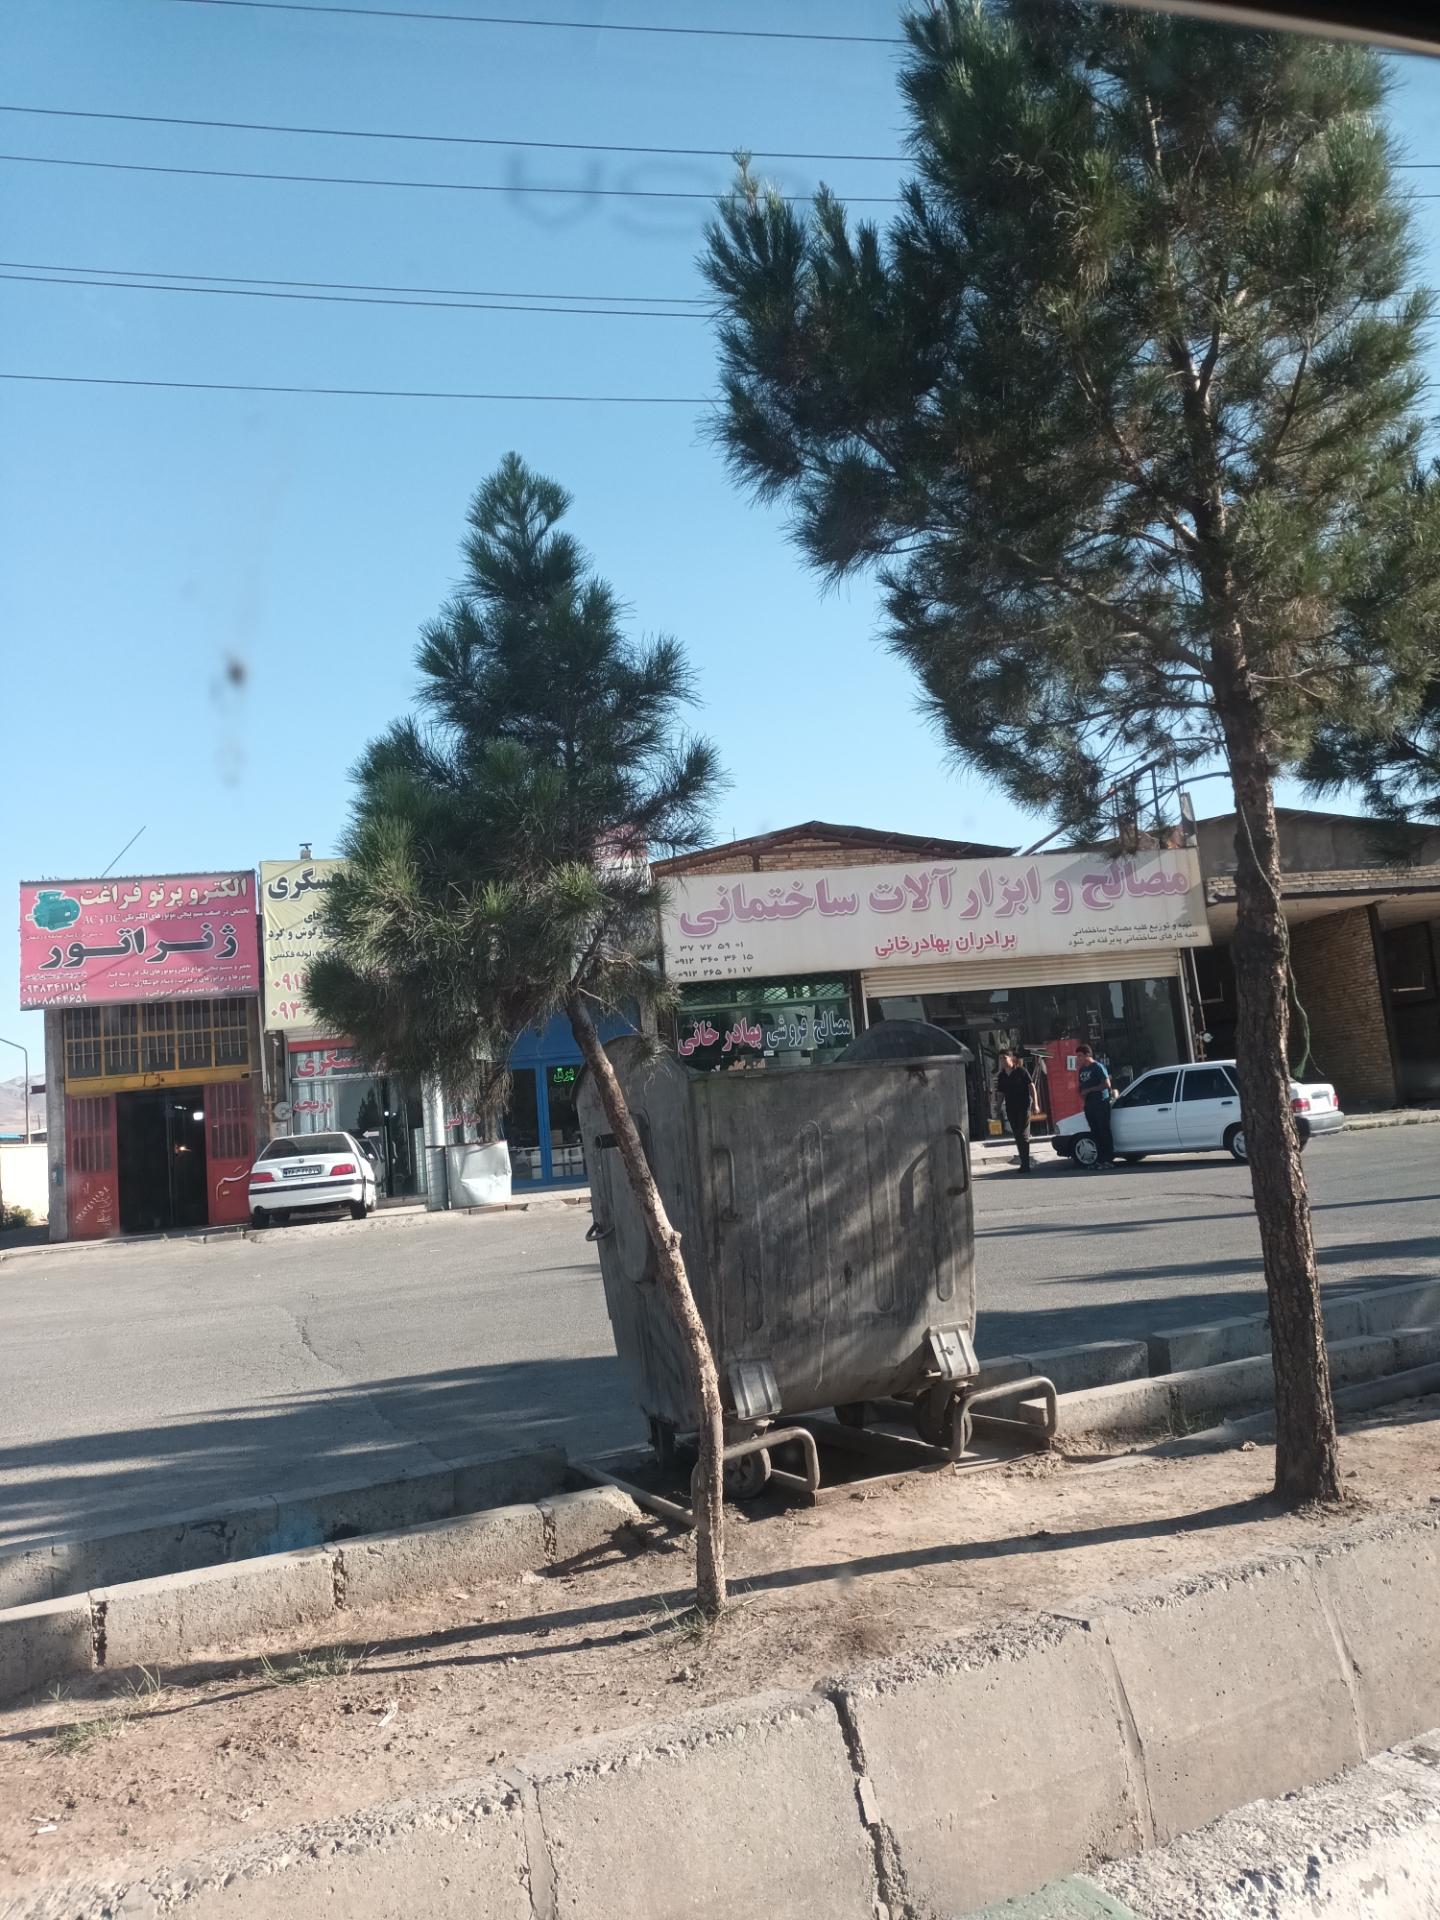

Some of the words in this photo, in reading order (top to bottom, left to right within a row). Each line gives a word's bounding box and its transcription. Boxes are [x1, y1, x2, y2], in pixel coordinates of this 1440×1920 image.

[80, 882, 142, 909] فراغت
[147, 882, 183, 908] پرتو
[188, 877, 247, 905] الکترو
[869, 865, 956, 913] آلات
[959, 864, 1041, 919] ابزار
[1051, 878, 1073, 913] و
[1081, 859, 1190, 910] مصالح
[106, 914, 121, 923] DC
[680, 878, 859, 937] ساختمانی
[83, 915, 97, 925] AC
[1072, 926, 1107, 936] ساختمانی
[1108, 924, 1132, 935] مصالح
[1149, 922, 1170, 933] توزیع
[39, 922, 239, 970] ژنراتور
[268, 928, 285, 941] گرد
[287, 931, 293, 940] و
[955, 930, 1017, 953] برادران
[1124, 933, 1158, 944] ساختمانی
[675, 957, 694, 965] ۰۹۱۲
[743, 953, 754, 961] ۱۵
[680, 944, 694, 952] ۳۷
[700, 943, 712, 951] ۷۲
[718, 942, 730, 950] ۵۹
[742, 966, 753, 974] ۱۷
[678, 1020, 720, 1056] خانی
[721, 1016, 762, 1051] بهادر
[766, 1008, 809, 1049] فروشی
[812, 1010, 852, 1045] مصالح
[292, 1098, 334, 1116] دریچه
